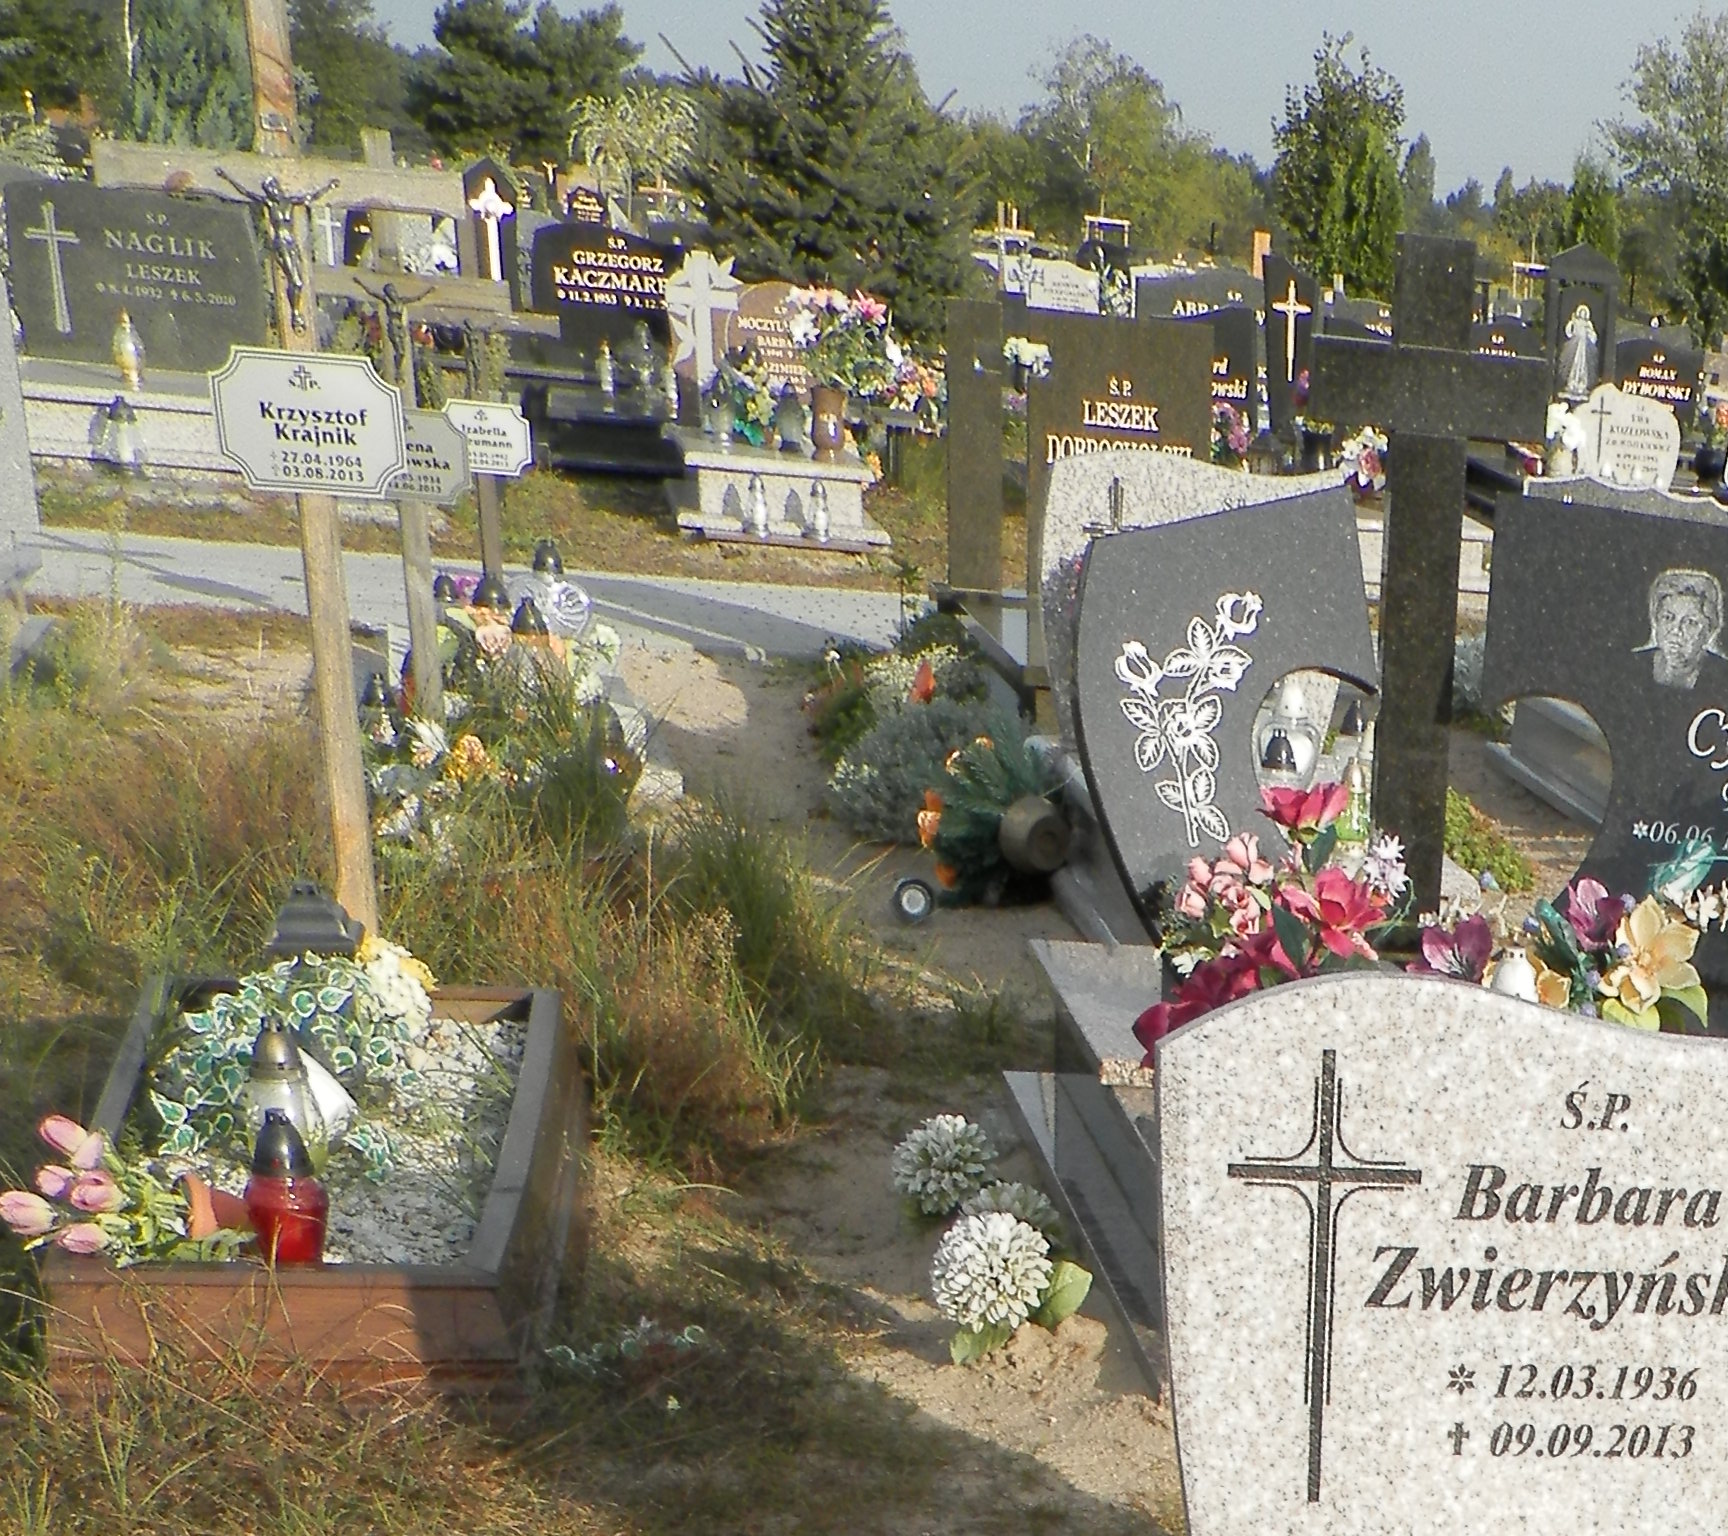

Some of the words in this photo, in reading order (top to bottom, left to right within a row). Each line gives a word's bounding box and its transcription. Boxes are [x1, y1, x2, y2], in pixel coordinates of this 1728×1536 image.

[102, 228, 217, 260] NAGLIK
[126, 263, 202, 285] LESZEK
[572, 250, 665, 273] GRZEGORZ
[553, 266, 669, 294] KACZMARE
[258, 401, 368, 427] Krzysztof
[1082, 399, 1160, 431] LESZEK
[275, 423, 358, 447] Krajnik
[281, 451, 363, 468] 27.04.1964
[282, 465, 365, 482] 03.08.2013
[1559, 1081, 1633, 1132] Ś.P.
[1452, 1162, 1723, 1230] Barbara
[1493, 1363, 1702, 1403] 12.03.1936
[1489, 1421, 1699, 1460] 09.09.2013
